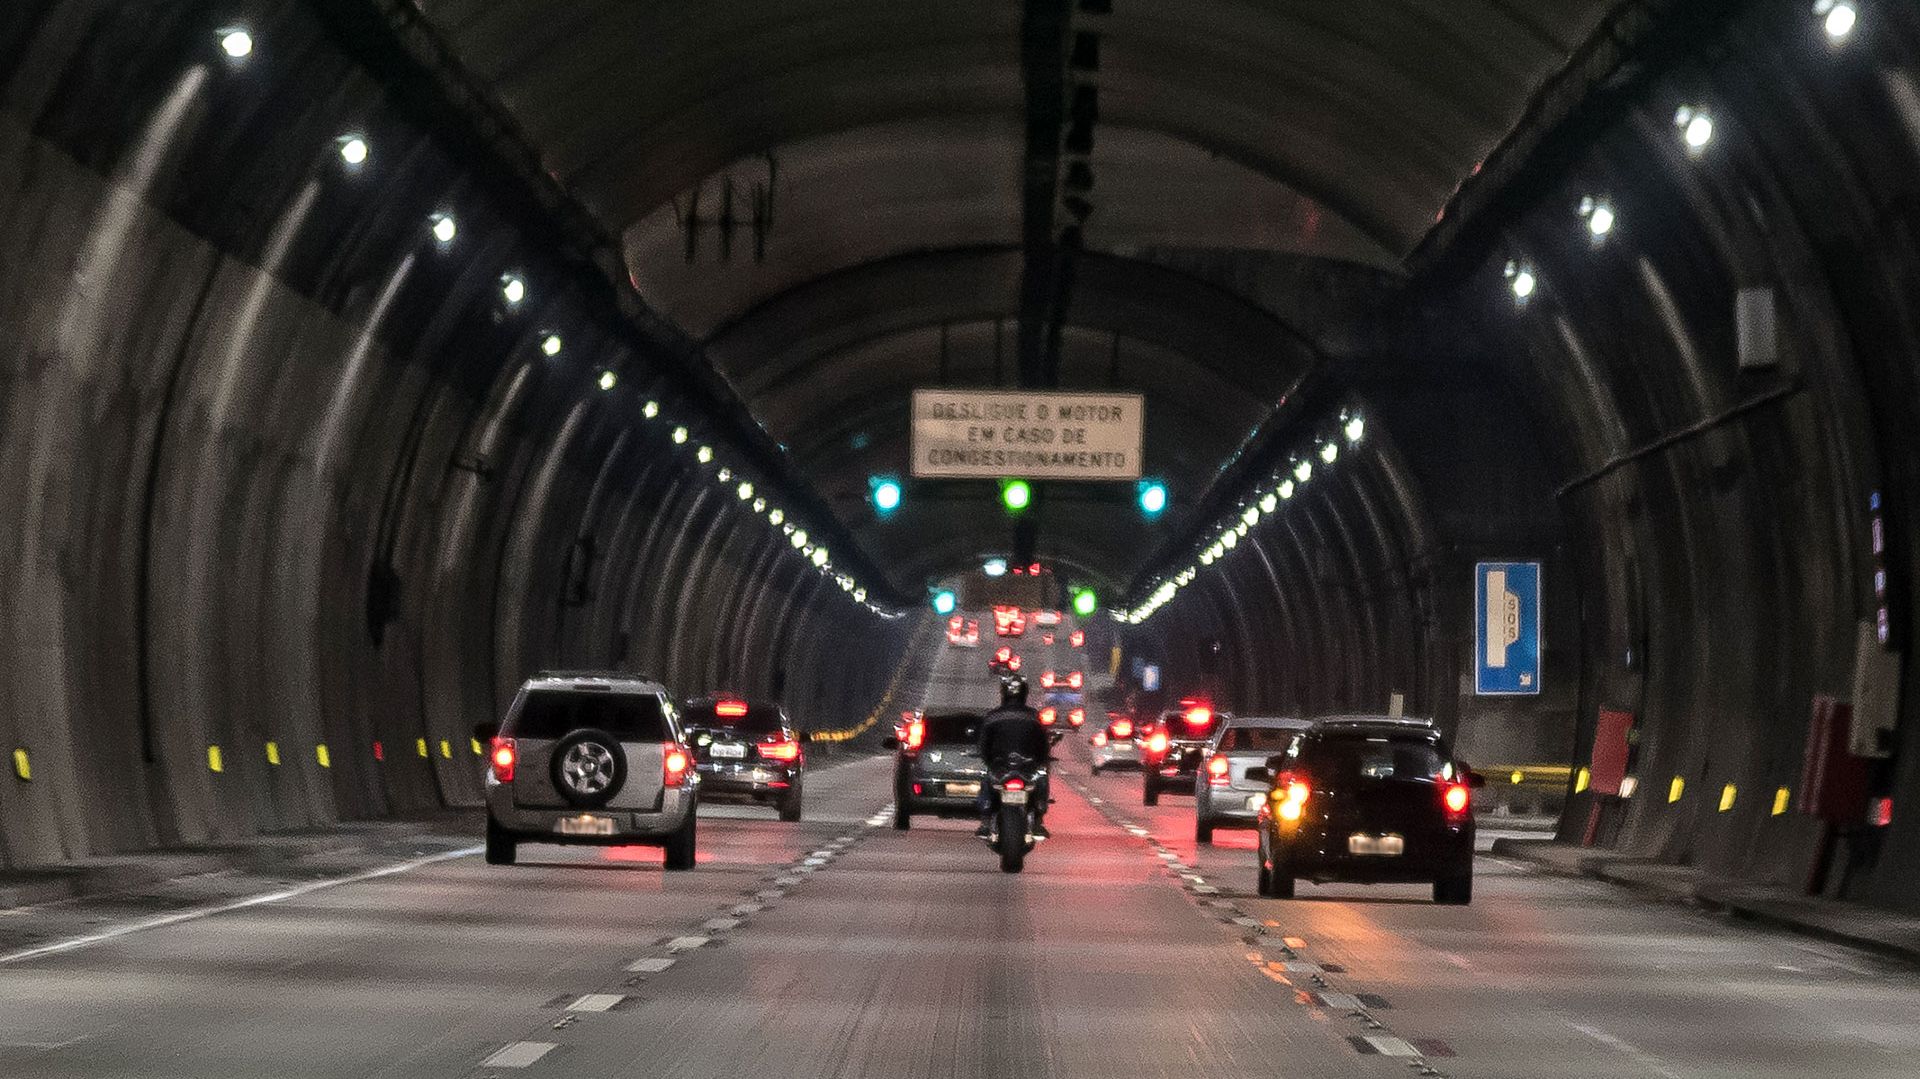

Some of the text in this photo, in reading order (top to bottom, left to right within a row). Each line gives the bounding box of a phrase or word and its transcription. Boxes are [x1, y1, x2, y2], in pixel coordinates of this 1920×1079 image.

[933, 402, 1122, 421] DESLIGUE O MOTOR
[967, 426, 1086, 444] EM CASO DE
[928, 448, 1126, 467] CONGESTIONAMENTO
[1507, 598, 1517, 638] SOS
